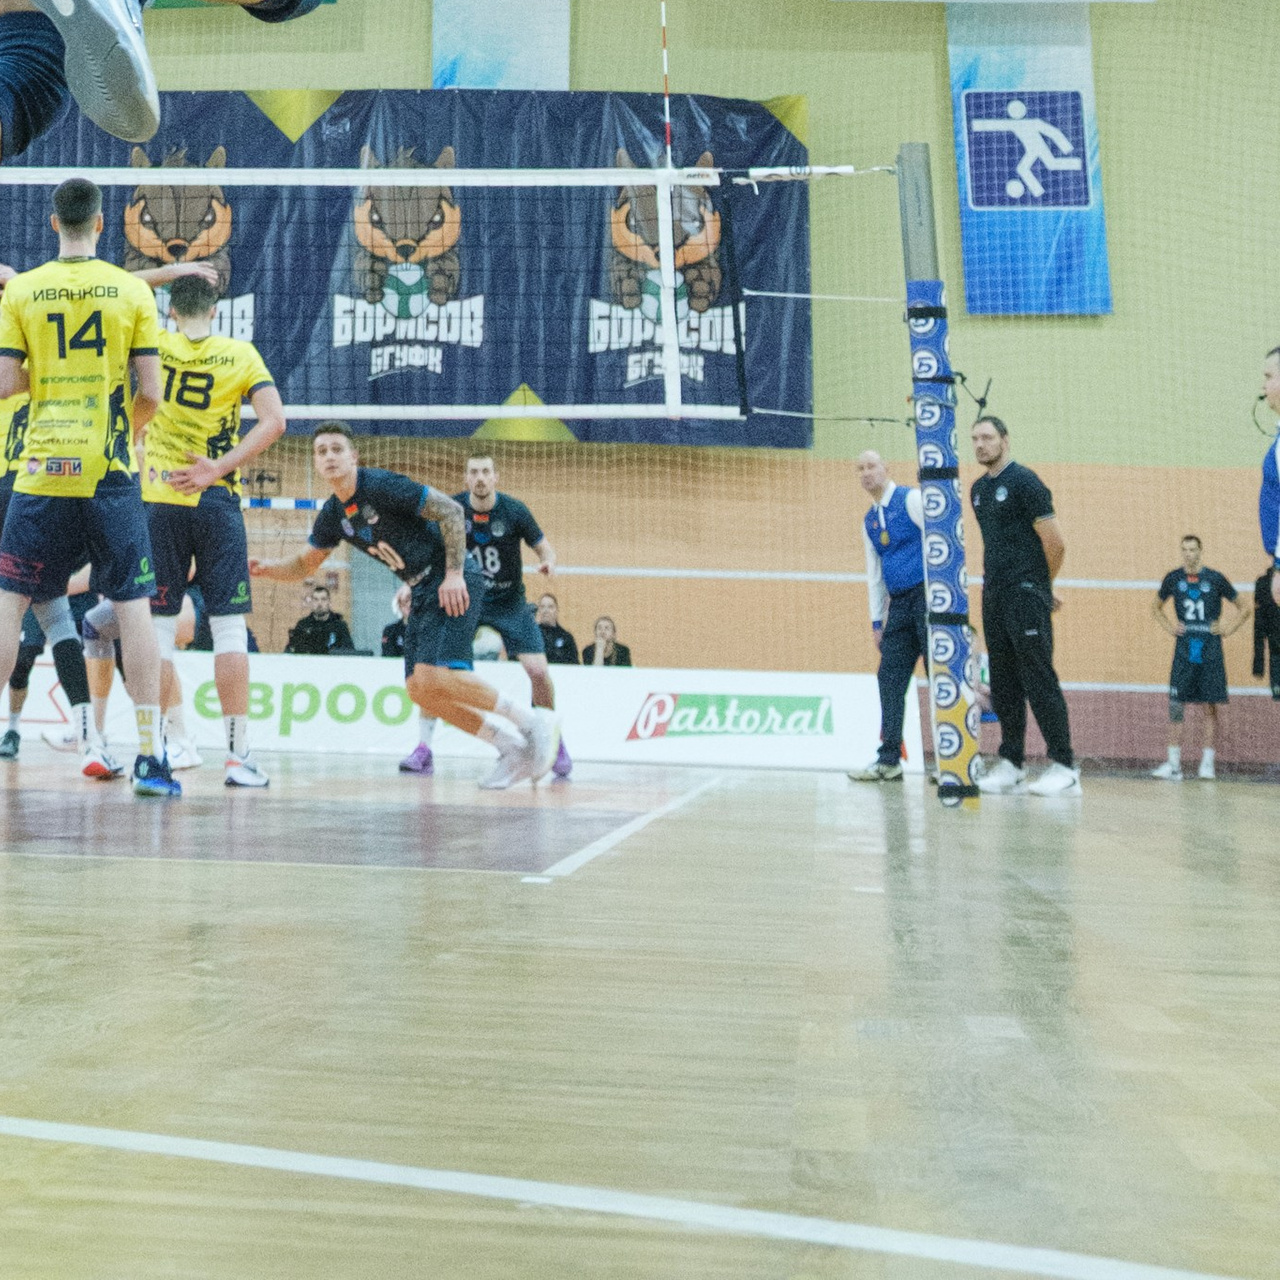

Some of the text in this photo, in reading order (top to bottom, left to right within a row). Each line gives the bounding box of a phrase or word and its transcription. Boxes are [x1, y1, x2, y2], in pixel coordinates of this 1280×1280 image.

[32, 285, 119, 302] ИВАНКОВ
[47, 310, 107, 360] 14
[333, 294, 485, 348] БОРИСОВ
[162, 364, 215, 410] 18
[1183, 599, 1206, 621] 21
[635, 693, 832, 740] Pastoral
